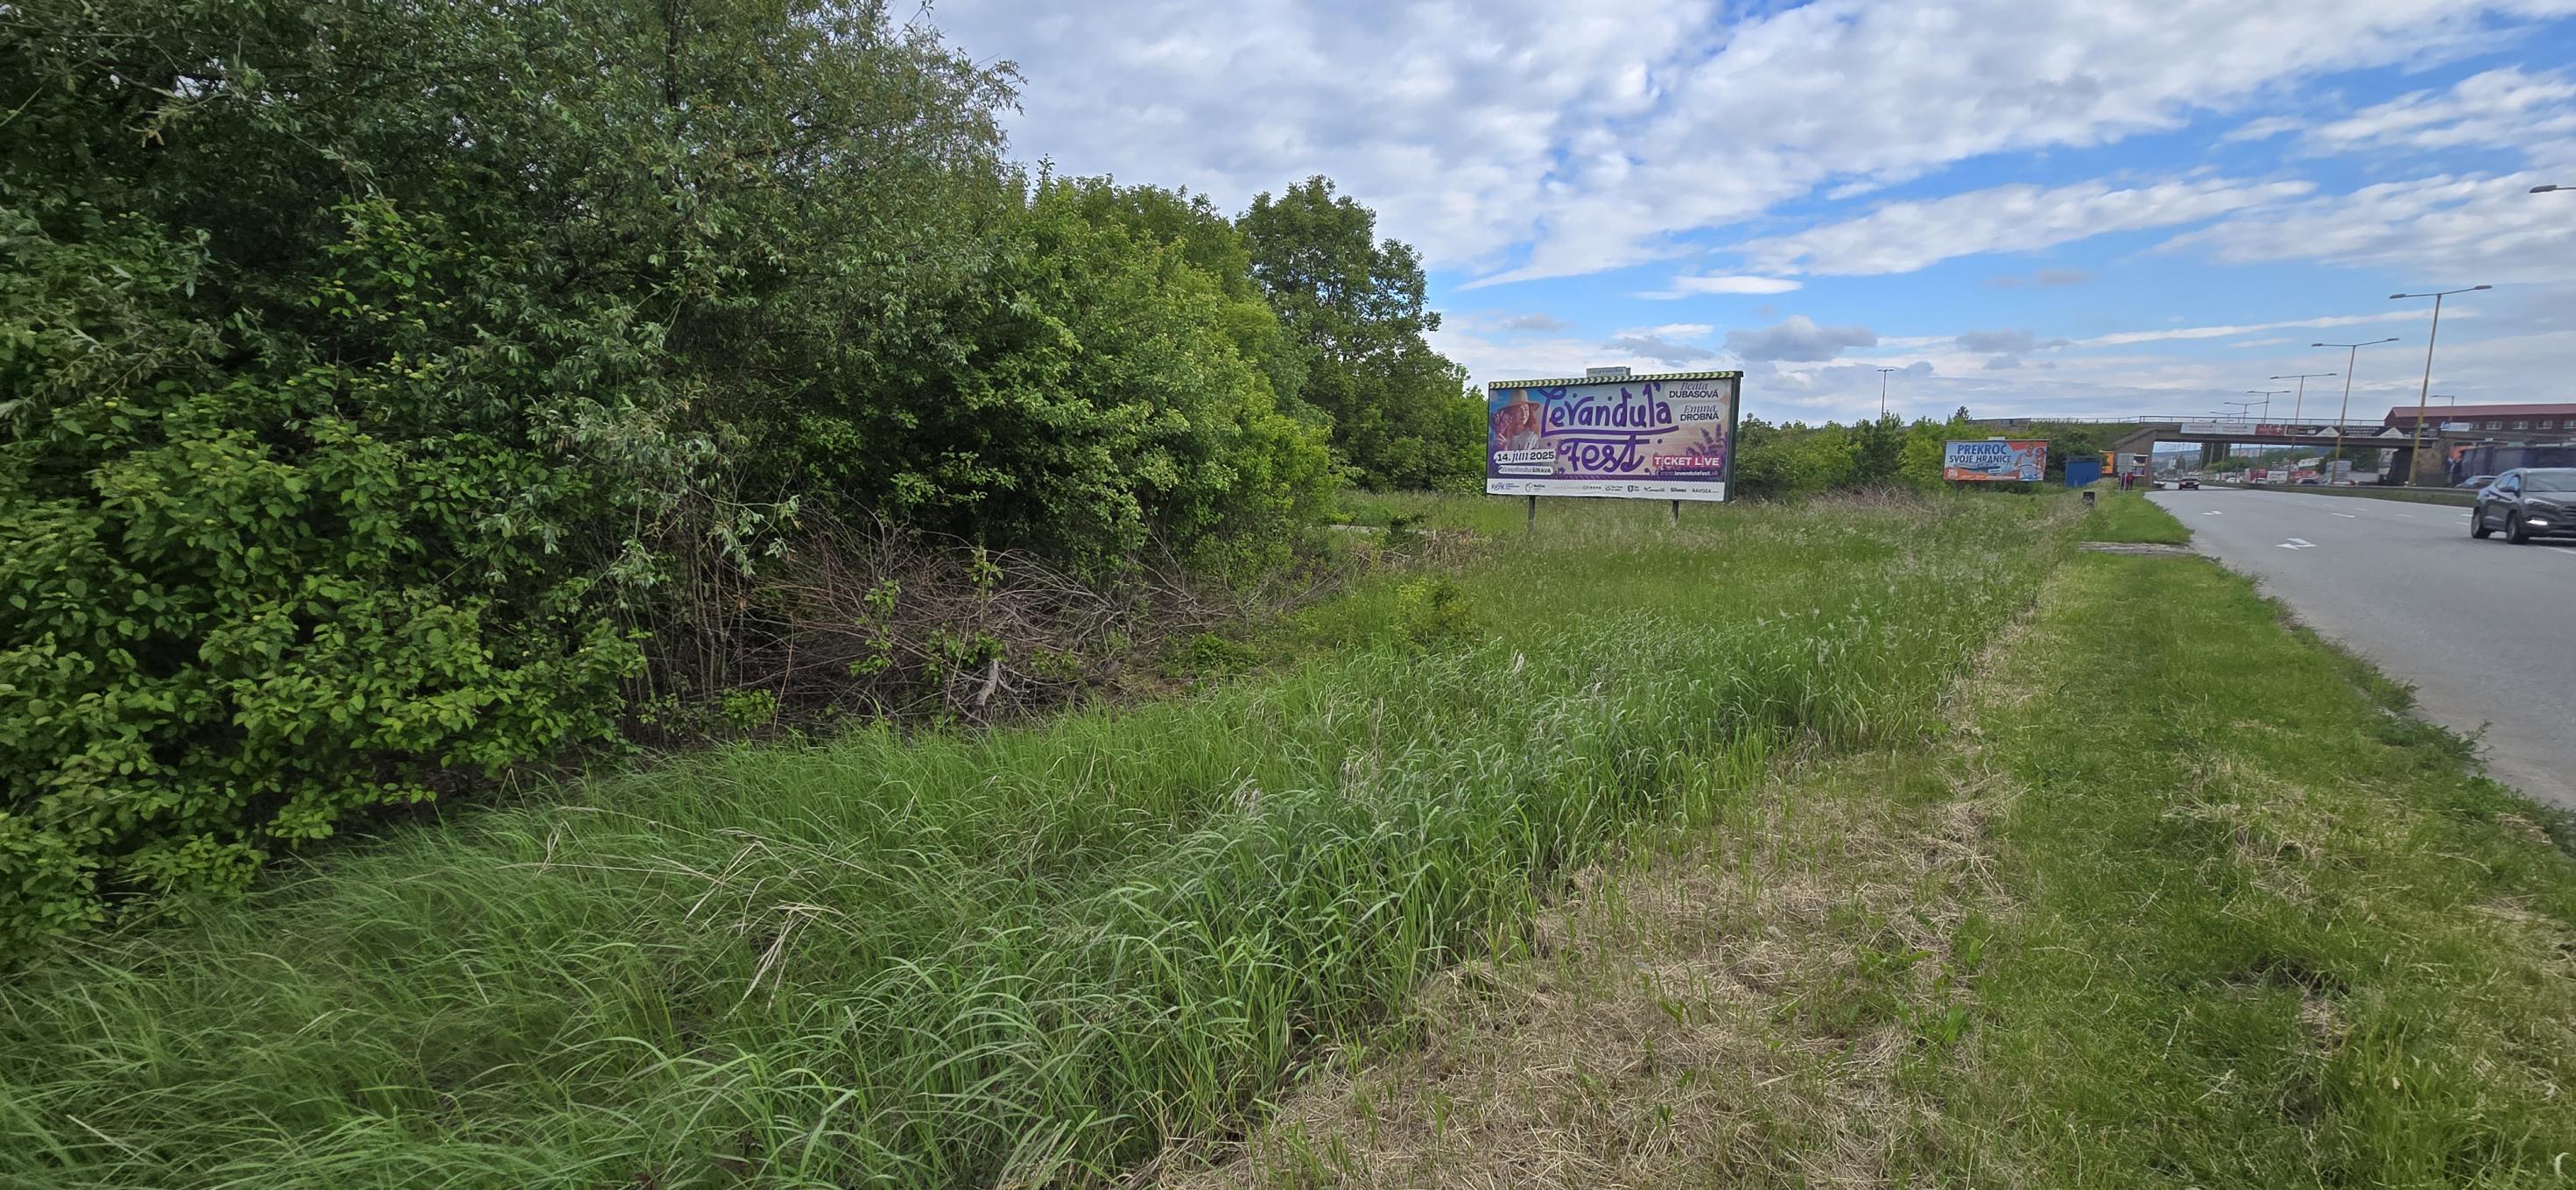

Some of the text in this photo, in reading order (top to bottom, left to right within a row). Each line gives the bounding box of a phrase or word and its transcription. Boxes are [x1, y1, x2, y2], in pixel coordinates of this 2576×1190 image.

[1669, 388, 1719, 398] DUBASOVÁ
[1680, 412, 1719, 421] DROBNÁ
[1497, 453, 1511, 461] 14.
[1530, 451, 1554, 461] 2025
[1559, 434, 1650, 473] Fest
[1949, 454, 2012, 463] SVOJE HRANICE
